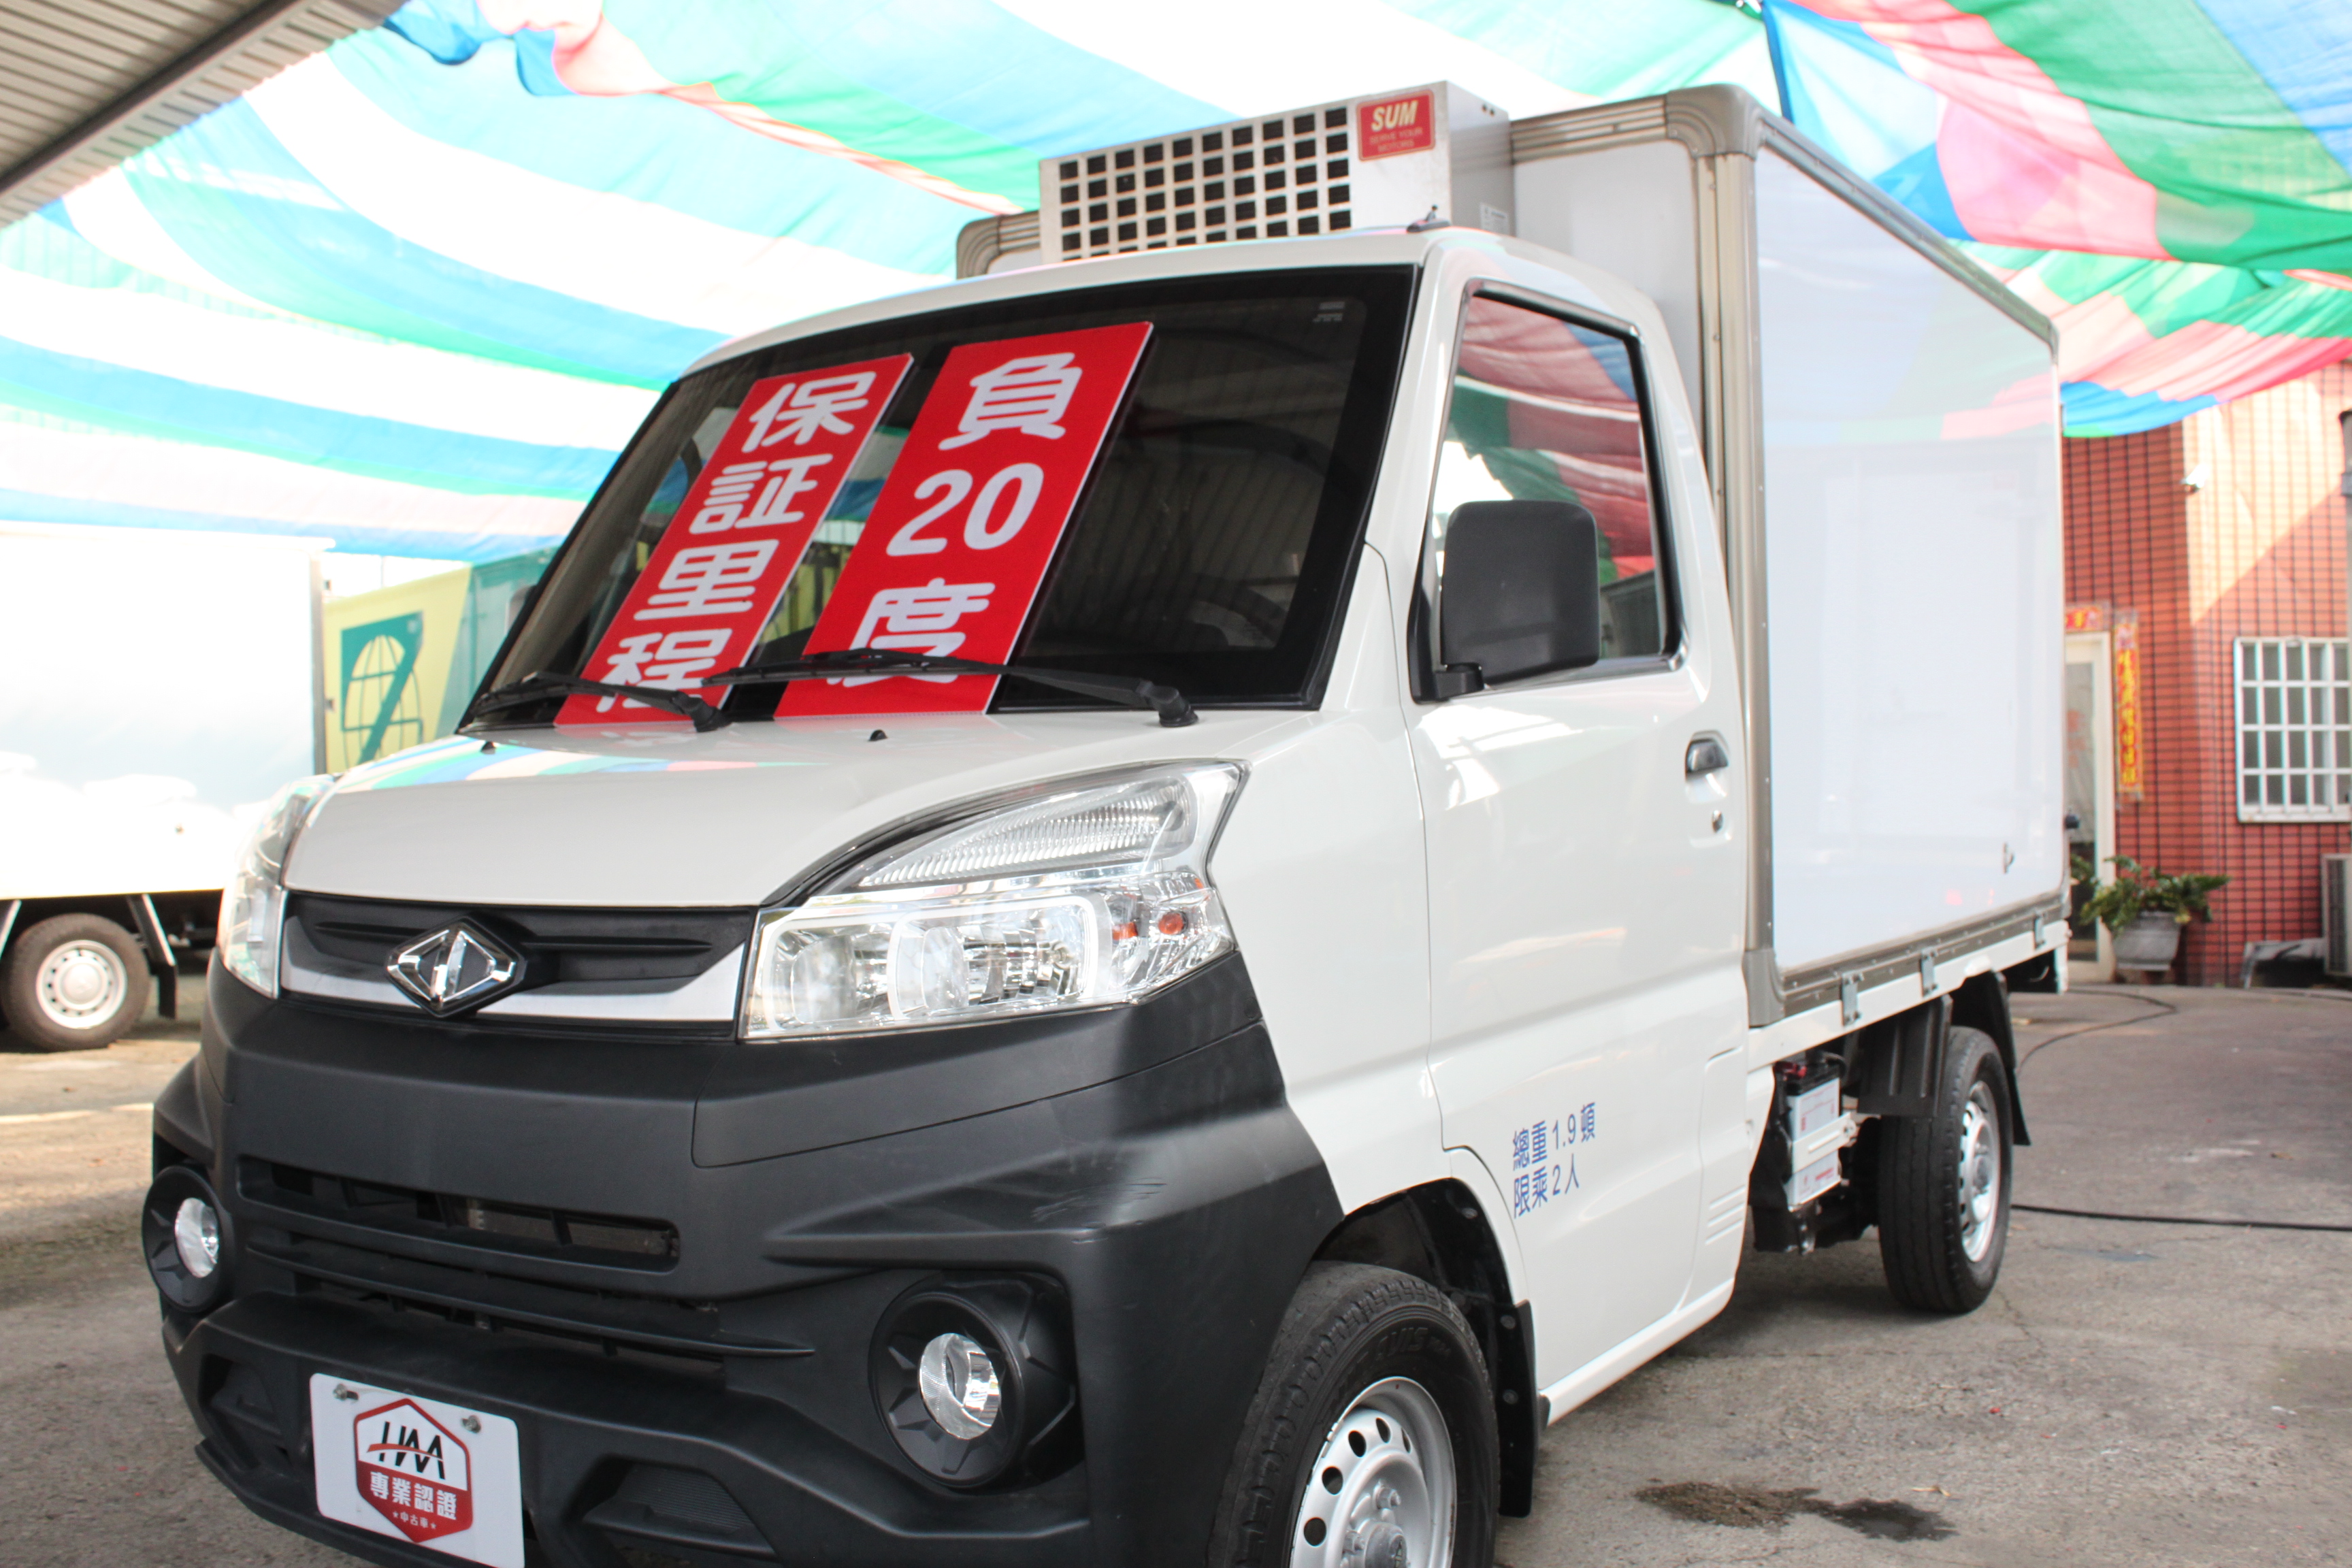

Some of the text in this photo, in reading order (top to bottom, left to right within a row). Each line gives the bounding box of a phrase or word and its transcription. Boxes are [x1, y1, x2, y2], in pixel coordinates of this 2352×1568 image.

[1371, 99, 1418, 131] SUM
[370, 1471, 457, 1520] 專業認證
[399, 1511, 429, 1529] 中古車
